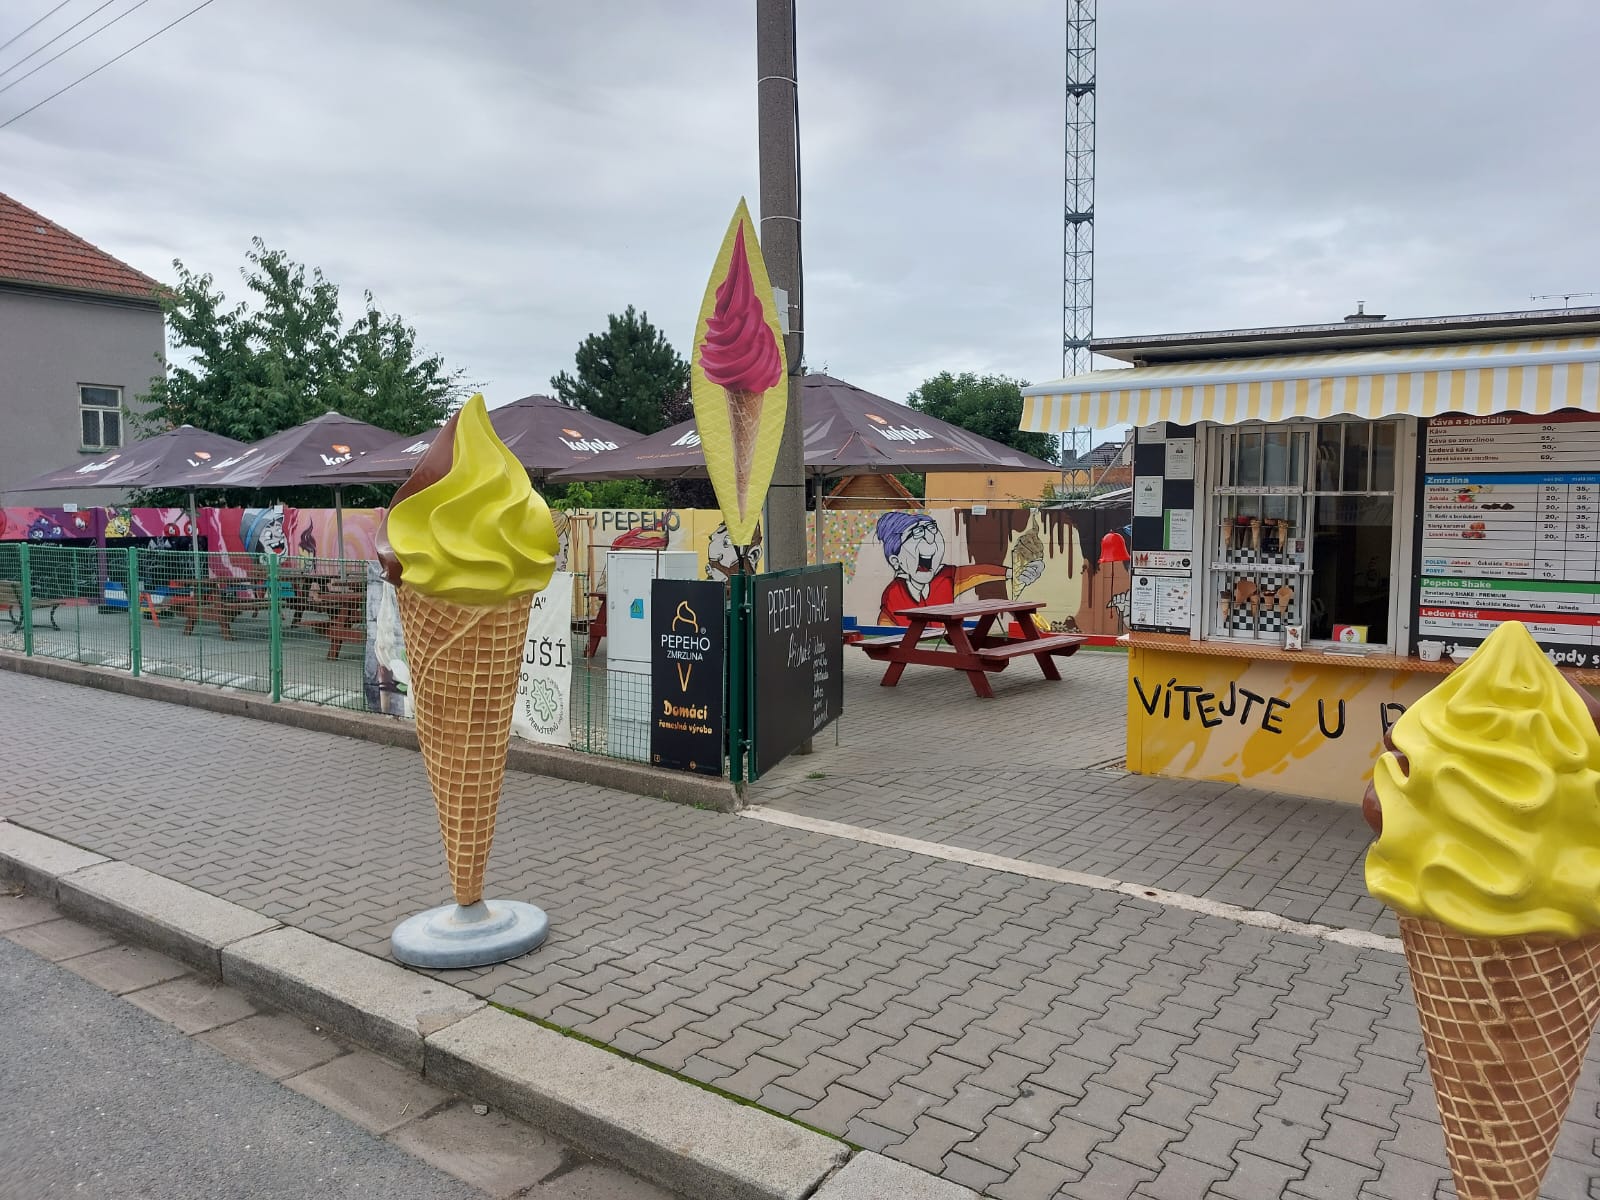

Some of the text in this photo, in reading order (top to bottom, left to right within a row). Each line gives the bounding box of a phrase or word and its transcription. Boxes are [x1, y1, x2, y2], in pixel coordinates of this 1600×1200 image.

[1430, 417, 1453, 426] Káva
[1464, 416, 1512, 425] speciality
[557, 435, 621, 455] kofola
[1427, 476, 1469, 484] Zmrzlina
[601, 511, 680, 532] PEPEHO
[1423, 578, 1492, 589] Pepeho Shake
[768, 586, 802, 635] PEPEHO
[1422, 609, 1479, 619] Ledová tříšť
[661, 634, 711, 651] PEPEHO
[666, 650, 703, 661] ZMRZLINA
[1133, 676, 1291, 735] VÍTEJTE
[1317, 699, 1346, 739] U
